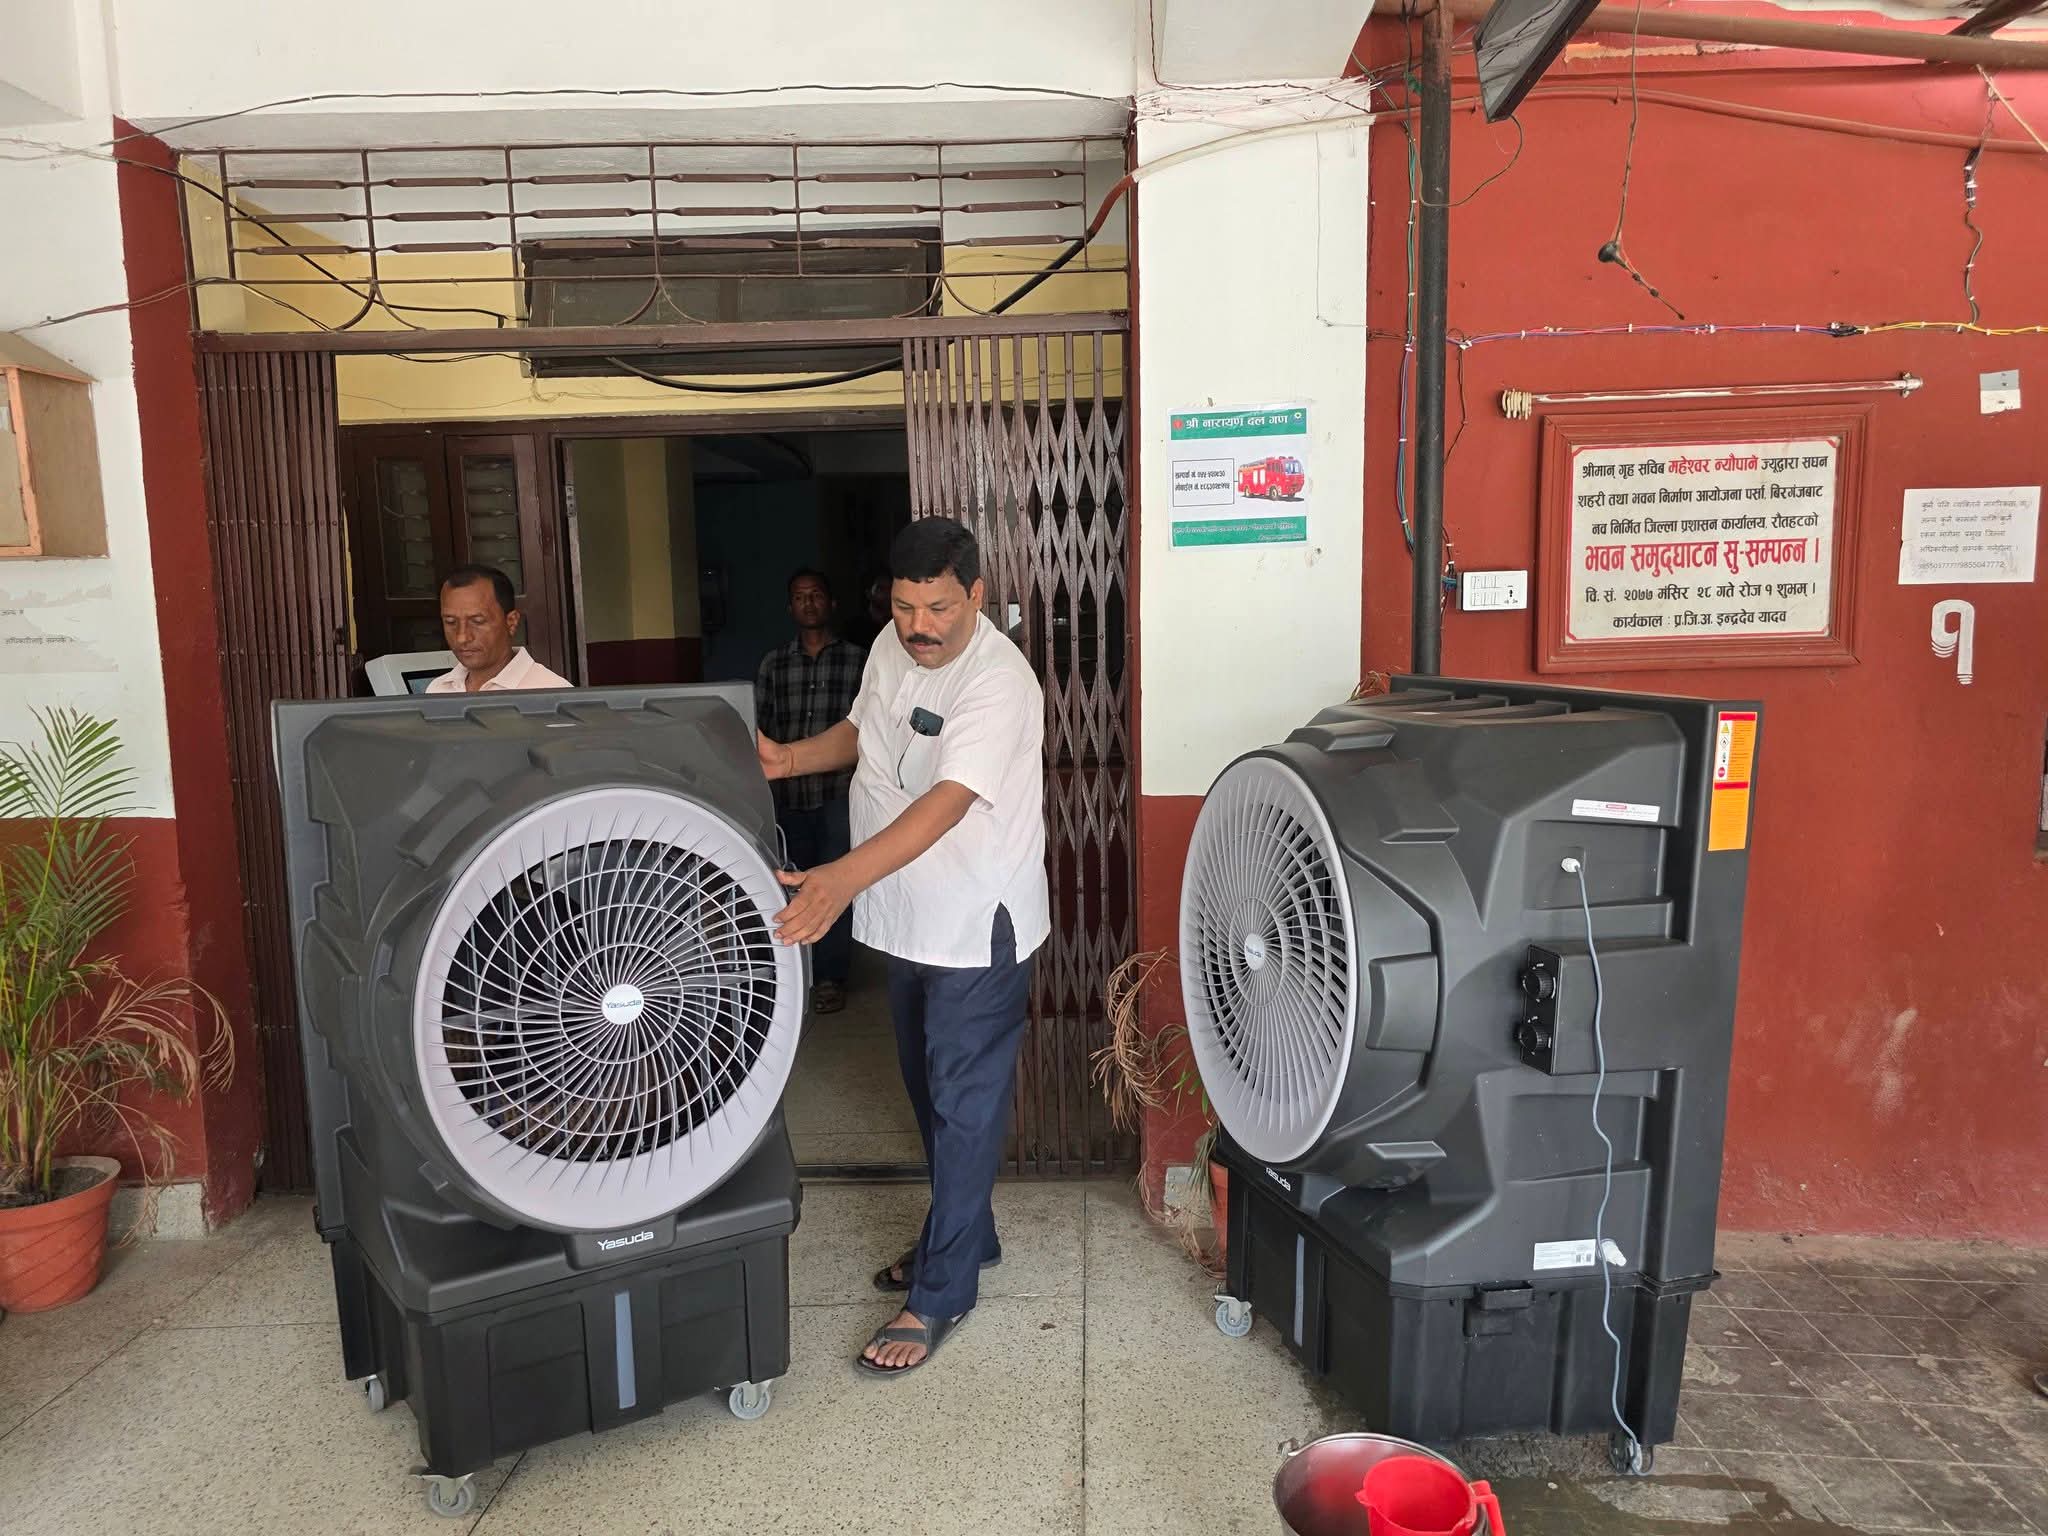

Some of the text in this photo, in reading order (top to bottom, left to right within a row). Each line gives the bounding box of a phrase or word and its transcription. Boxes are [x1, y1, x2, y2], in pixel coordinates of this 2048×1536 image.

[1186, 416, 1199, 429] श्री
[1202, 414, 1243, 427] नारायण
[1269, 414, 1288, 425] गण
[1583, 463, 1615, 479] श्रीमान्
[1619, 464, 1635, 479] गृह
[1668, 456, 1711, 475] महेश्वर
[1715, 453, 1759, 471] न्यौपाने
[1578, 491, 1606, 508] शहरी
[1608, 493, 1629, 506] तथा
[1632, 492, 1656, 504] भवन
[1659, 488, 1693, 503] निर्माण
[1696, 486, 1742, 502] आयोजना
[1592, 524, 1608, 535] नव
[1610, 519, 1641, 534] निर्मित
[1644, 518, 1678, 533] जिल्ला
[1681, 519, 1718, 533] प्रशासन
[1771, 512, 1818, 528] रौतहटको
[1585, 545, 1626, 571] भवन
[1624, 589, 1653, 601] २०७७
[1658, 584, 1690, 600] मंसिर
[1697, 586, 1711, 598] २८
[1716, 582, 1735, 598] गते
[1739, 581, 1762, 597] रोज
[1765, 584, 1772, 596] १
[1777, 583, 1808, 598] शुभम्
[1613, 615, 1663, 628] कार्यकाल
[1717, 610, 1755, 626] इन्द्रदेव
[1758, 611, 1787, 623] यादव
[606, 999, 642, 1009] Yasuda
[597, 1231, 654, 1251] Yasuda
